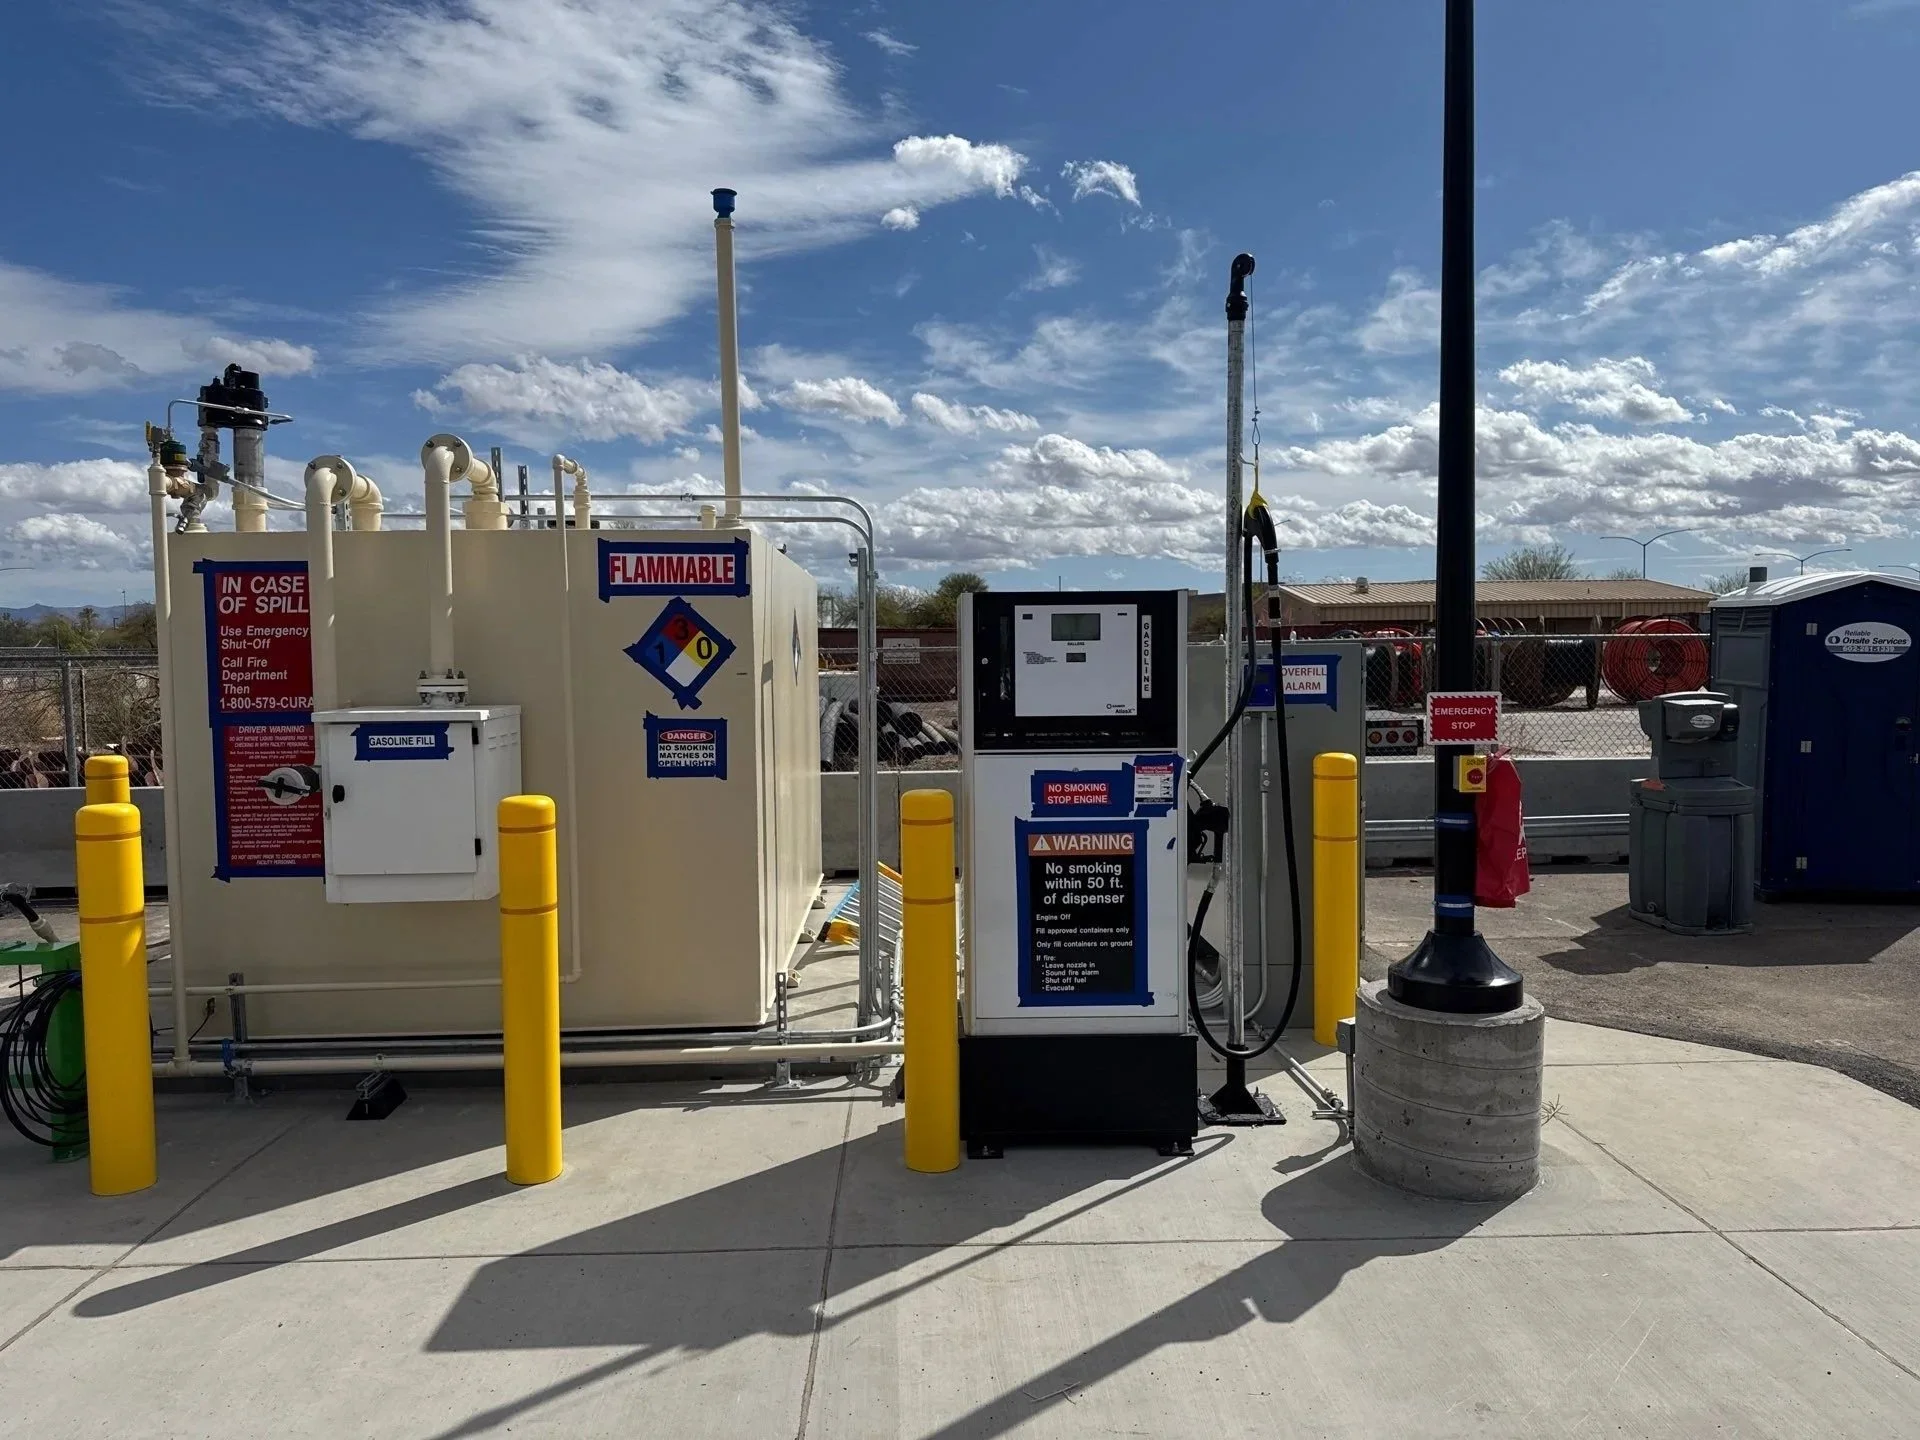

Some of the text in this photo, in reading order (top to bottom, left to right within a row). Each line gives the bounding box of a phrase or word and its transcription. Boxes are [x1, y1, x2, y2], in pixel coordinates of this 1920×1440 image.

[610, 556, 734, 584] FLAMMABLE
[222, 576, 305, 594] IN CASE
[219, 596, 309, 614] OF SPILL
[220, 625, 309, 638] Use Emergency
[673, 618, 689, 641] 3
[221, 638, 271, 649] Shut-Off
[696, 636, 713, 660] 0
[653, 641, 665, 664] 1
[222, 657, 267, 667] Call Fire
[222, 670, 288, 682] Department
[1282, 667, 1327, 676] OVERFILL
[224, 684, 250, 694] Then
[1285, 681, 1321, 691] ALARM
[220, 697, 314, 709] 1-800-579-CURA
[1435, 708, 1493, 716] EMERGENCY
[238, 725, 305, 734] DRIVER WARNING
[1451, 721, 1476, 730] STOP
[369, 736, 434, 746] GASOLINE FILL
[684, 759, 715, 767] LIGHTS
[1048, 783, 1107, 793] NO SMOKING
[1048, 795, 1108, 804] STOP ENGINE
[1052, 834, 1133, 850] WARNING
[1046, 862, 1122, 875] No smoking
[1045, 876, 1124, 889] within 50 ft.
[1043, 892, 1124, 906] of dispenser
[1116, 926, 1130, 934] only
[1110, 940, 1133, 948] ground
